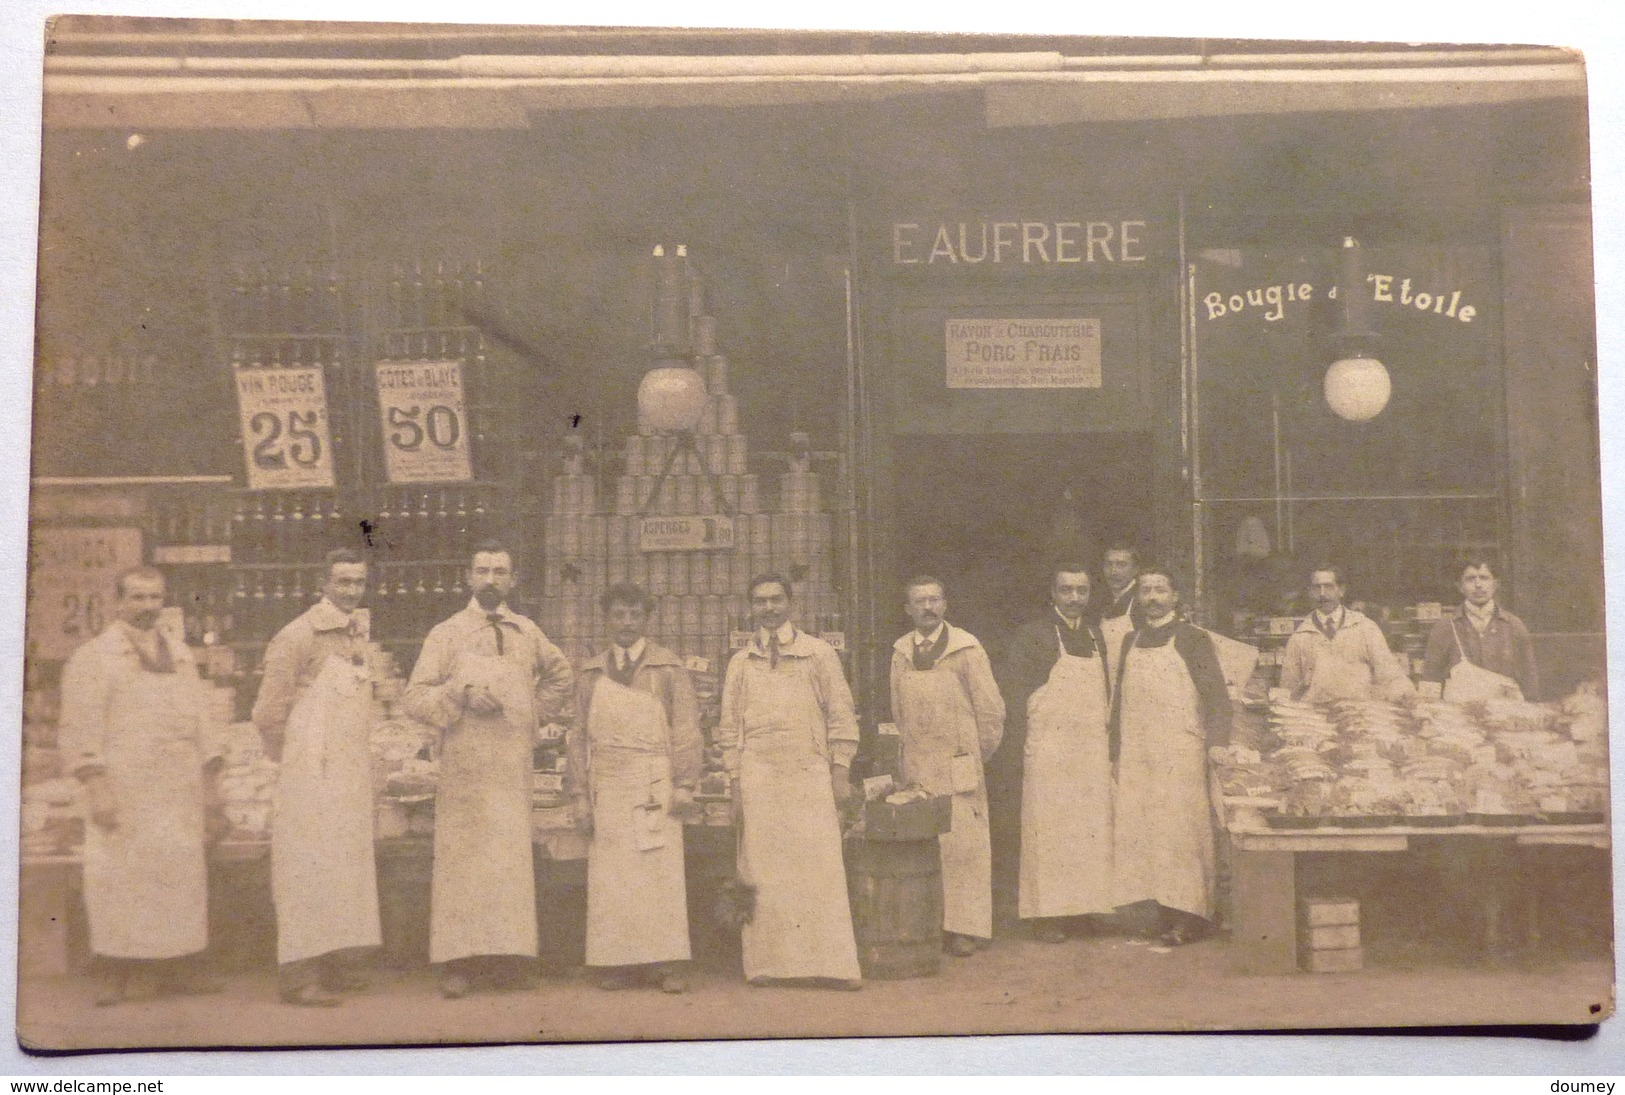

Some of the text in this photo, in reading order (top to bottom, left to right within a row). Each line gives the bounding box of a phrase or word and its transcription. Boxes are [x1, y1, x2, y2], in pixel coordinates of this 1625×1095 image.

[1203, 273, 1477, 323] Bougie d 'Etoile
[965, 340, 1081, 362] PORC FRAIS
[268, 373, 315, 393] ROUGE
[250, 410, 321, 470] 25
[387, 405, 459, 452] 50
